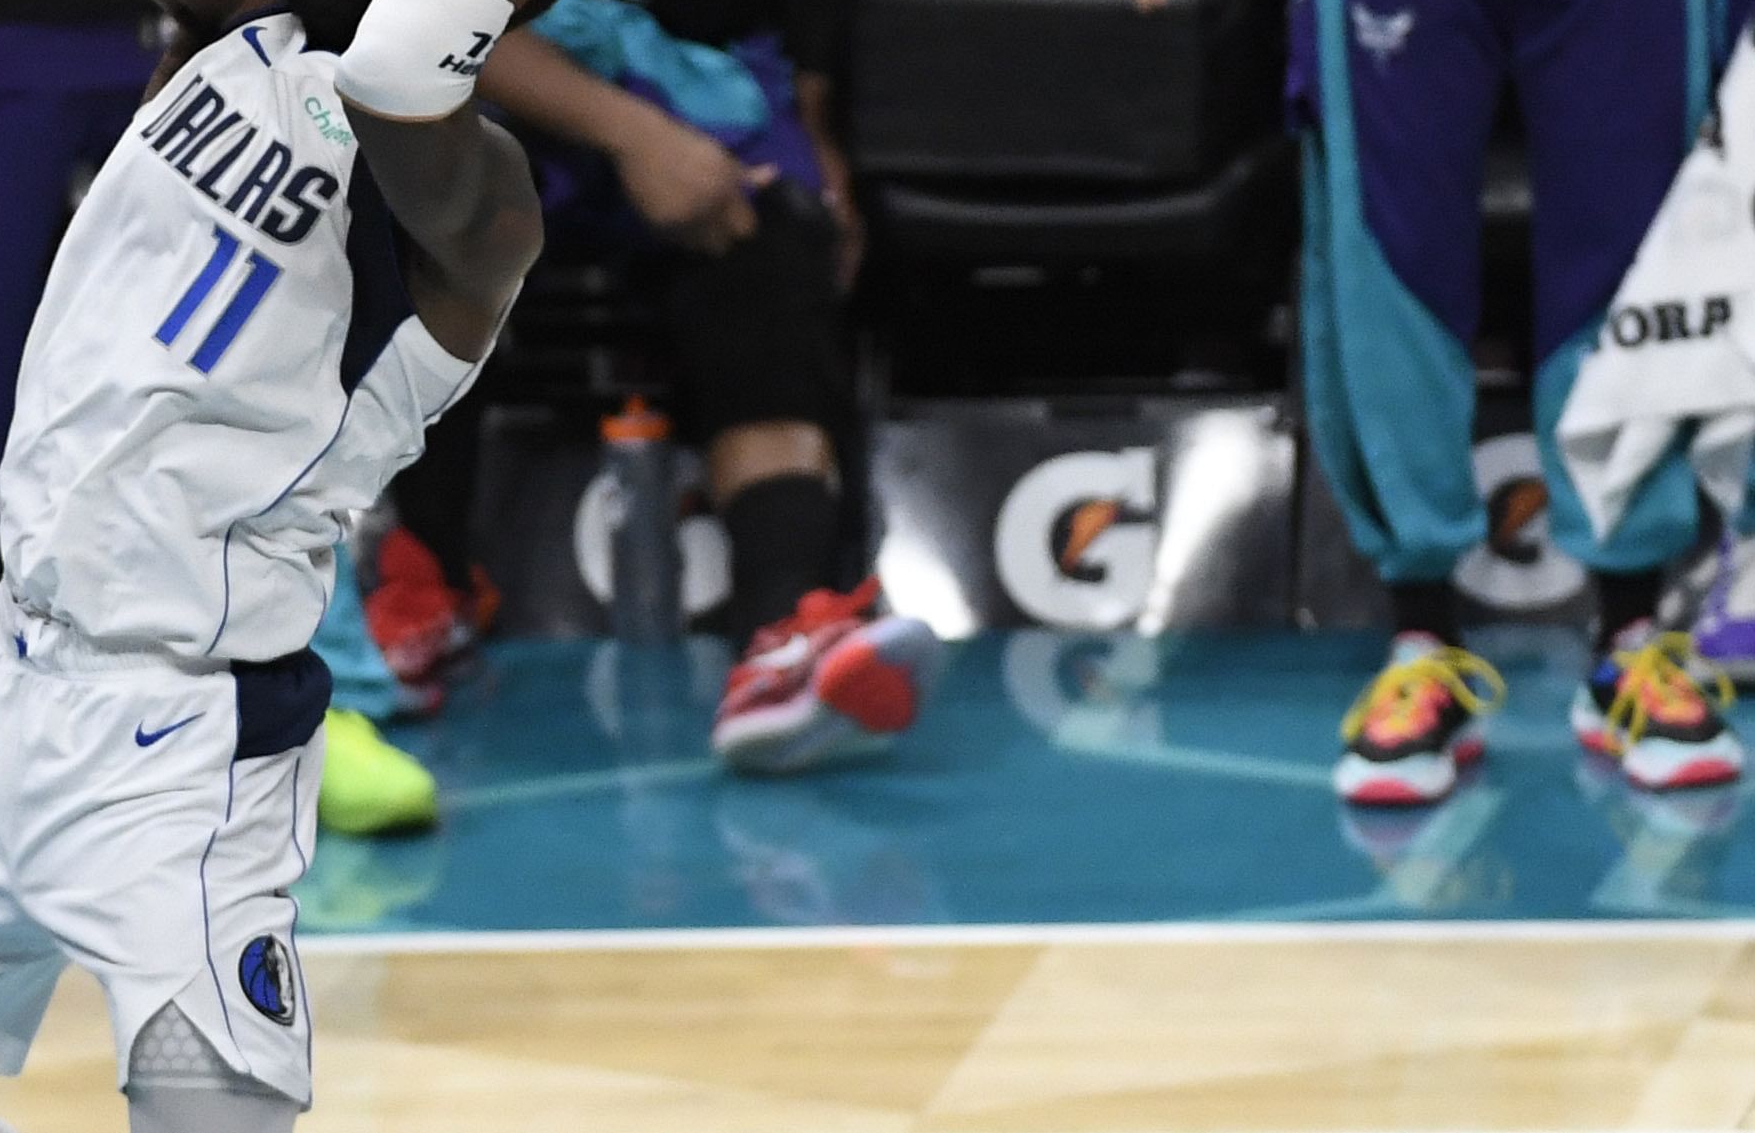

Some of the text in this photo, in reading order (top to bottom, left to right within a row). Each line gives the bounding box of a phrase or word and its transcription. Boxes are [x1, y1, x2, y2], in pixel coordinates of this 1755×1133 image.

[140, 74, 340, 244] DALLAS
[152, 222, 285, 379] 11
[995, 445, 1156, 625] G
